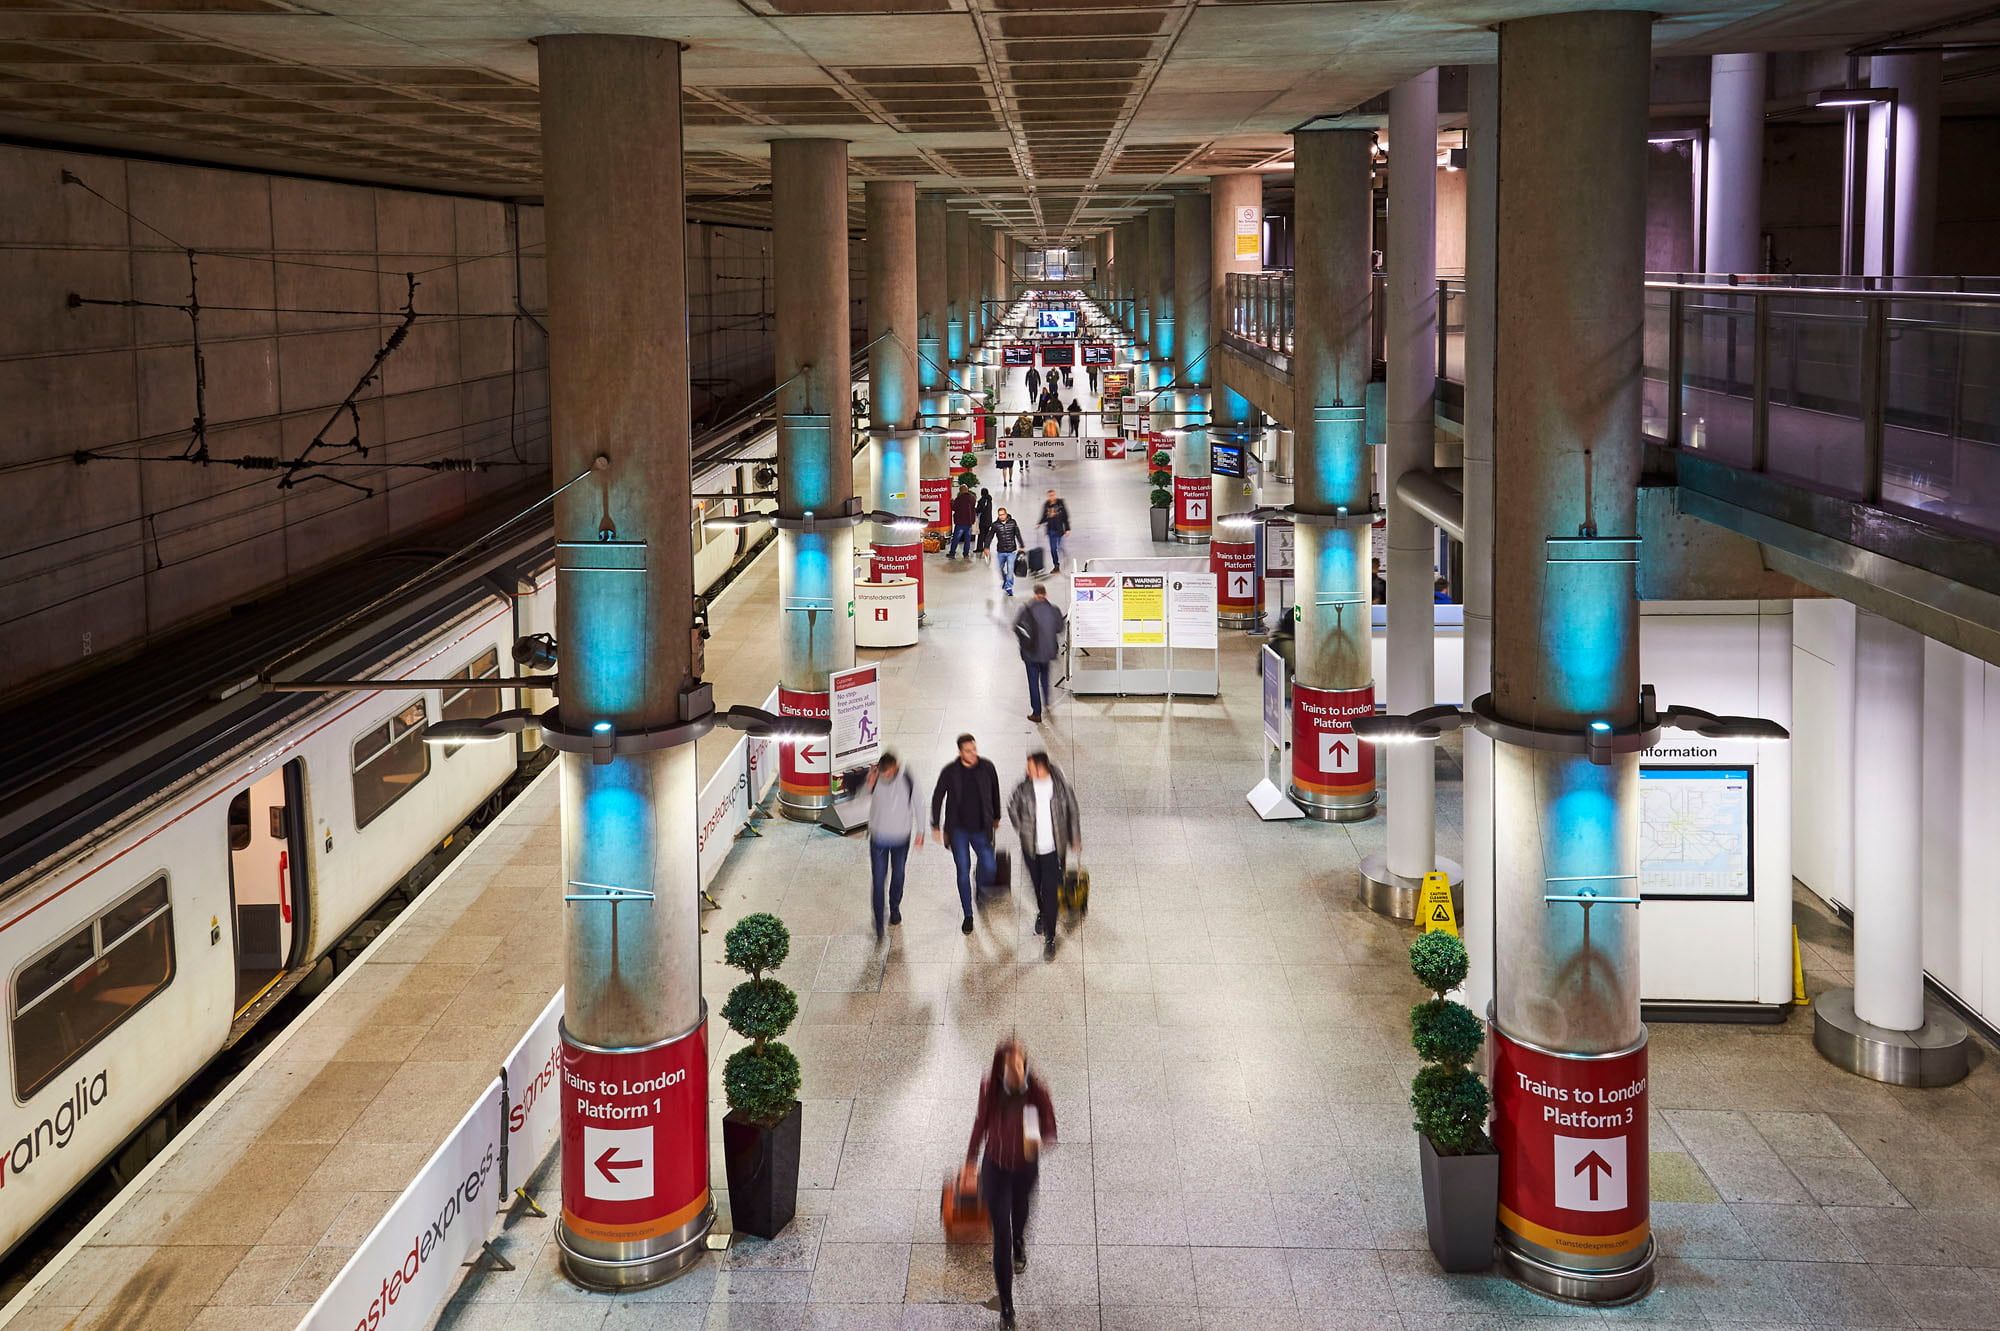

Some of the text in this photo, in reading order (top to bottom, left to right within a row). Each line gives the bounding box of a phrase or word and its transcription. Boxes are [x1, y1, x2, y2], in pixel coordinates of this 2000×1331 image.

[1216, 552, 1233, 560] Trains
[781, 703, 801, 716] Trains
[803, 708, 813, 716] to
[837, 700, 875, 714] Tottenham Hale
[1301, 701, 1371, 715] Trains to London
[563, 1065, 686, 1096] Trains to London
[1517, 1072, 1646, 1104] Trains to London
[578, 1098, 661, 1120] Platform 1
[1544, 1105, 1633, 1127] Platform 3
